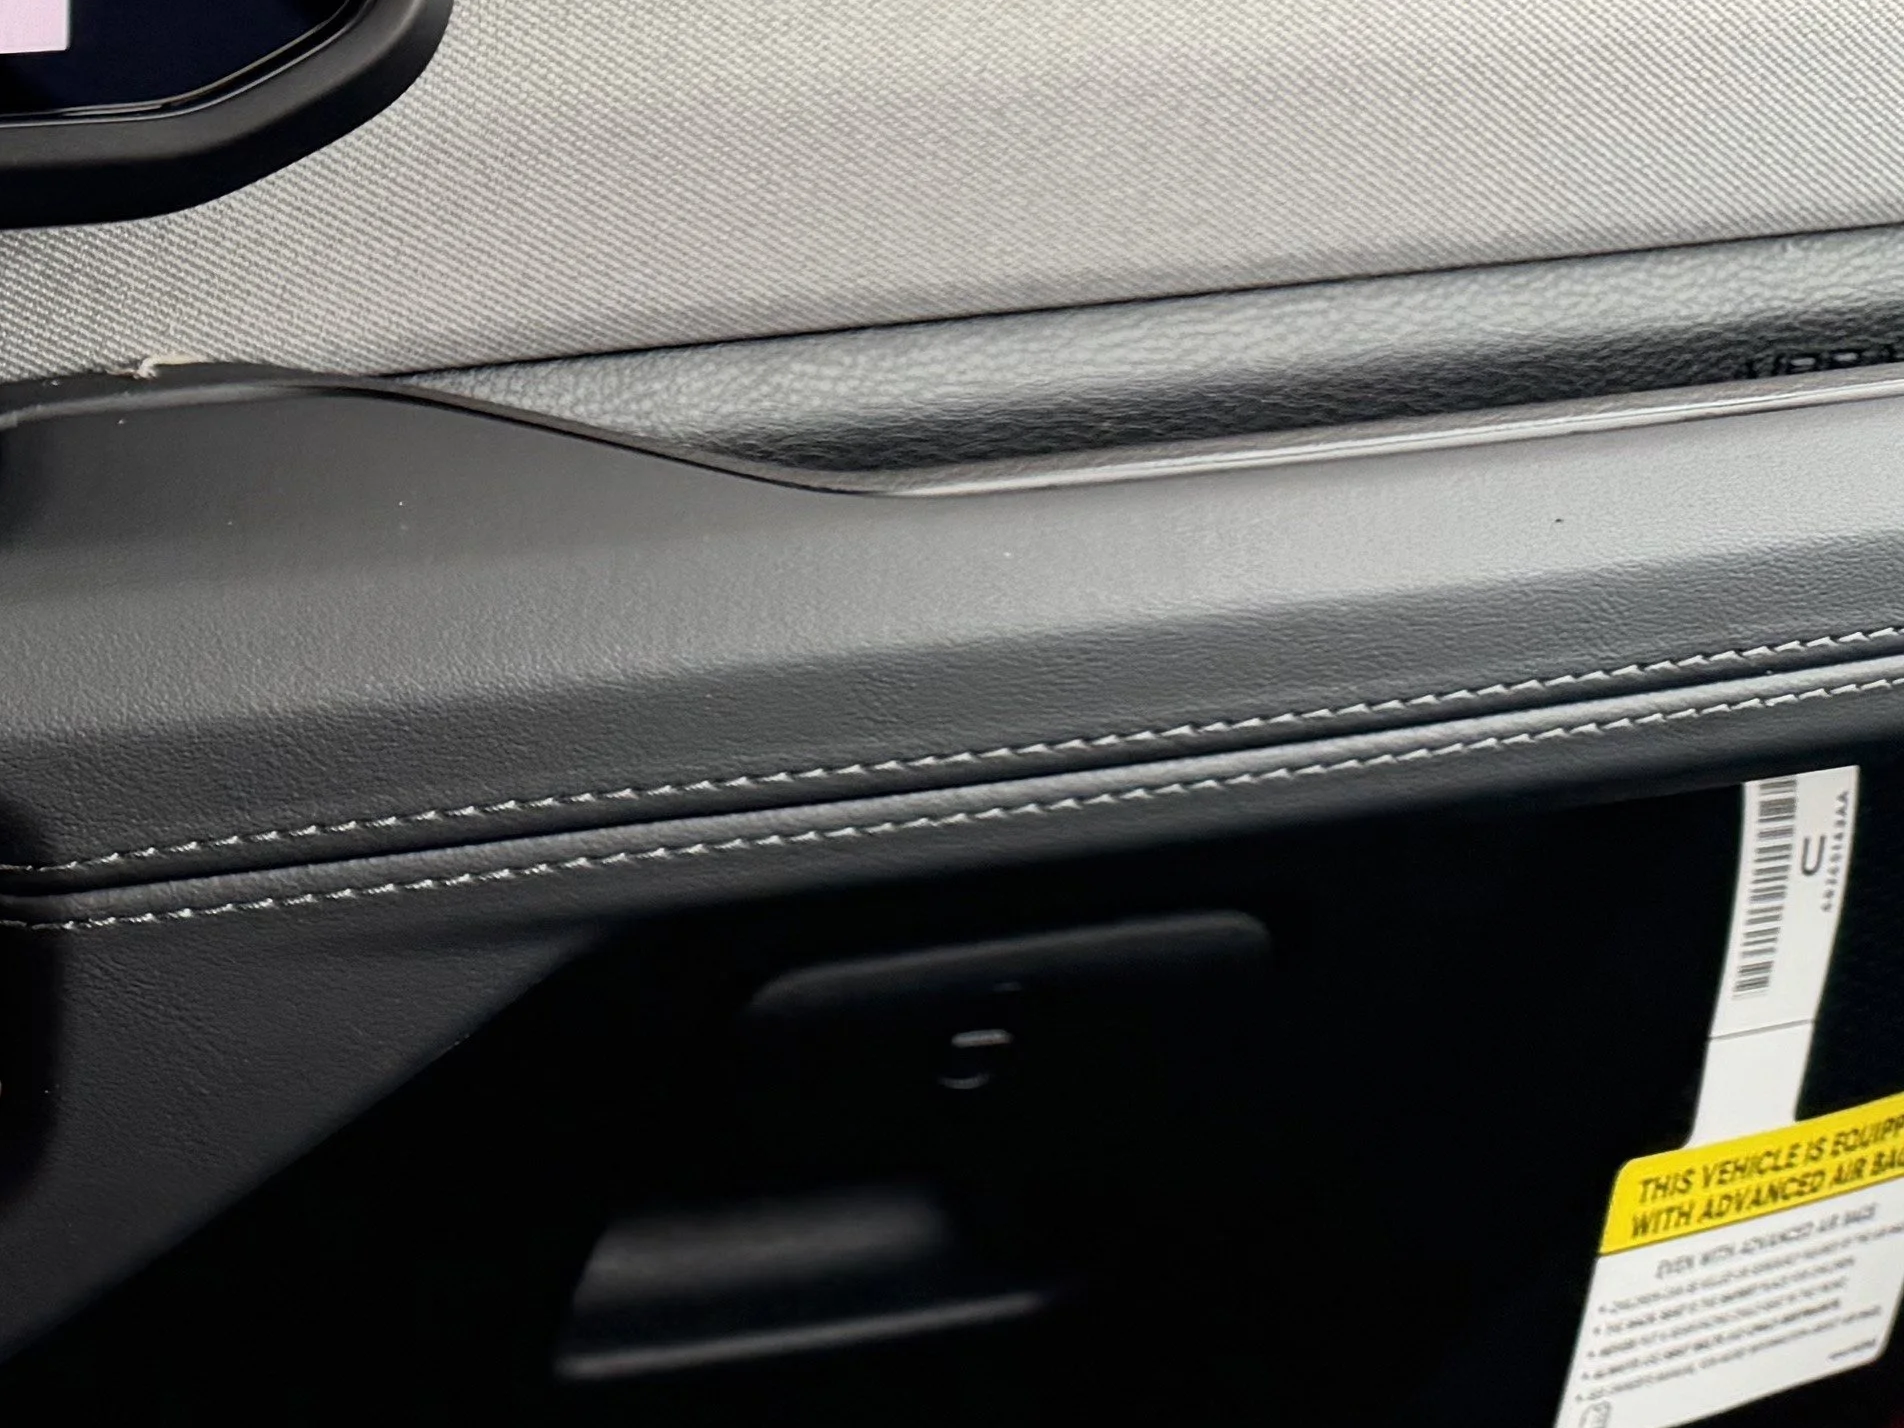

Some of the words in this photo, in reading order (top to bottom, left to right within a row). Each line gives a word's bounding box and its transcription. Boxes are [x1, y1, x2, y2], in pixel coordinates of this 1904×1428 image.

[1631, 1204, 1691, 1240] WITH
[1698, 1169, 1827, 1223] ADVANCED
[1830, 1157, 1867, 1187] AIR
[1638, 1168, 1695, 1202] THIS
[1701, 1142, 1801, 1188] VEHICLE
[1804, 1137, 1826, 1163] IS
